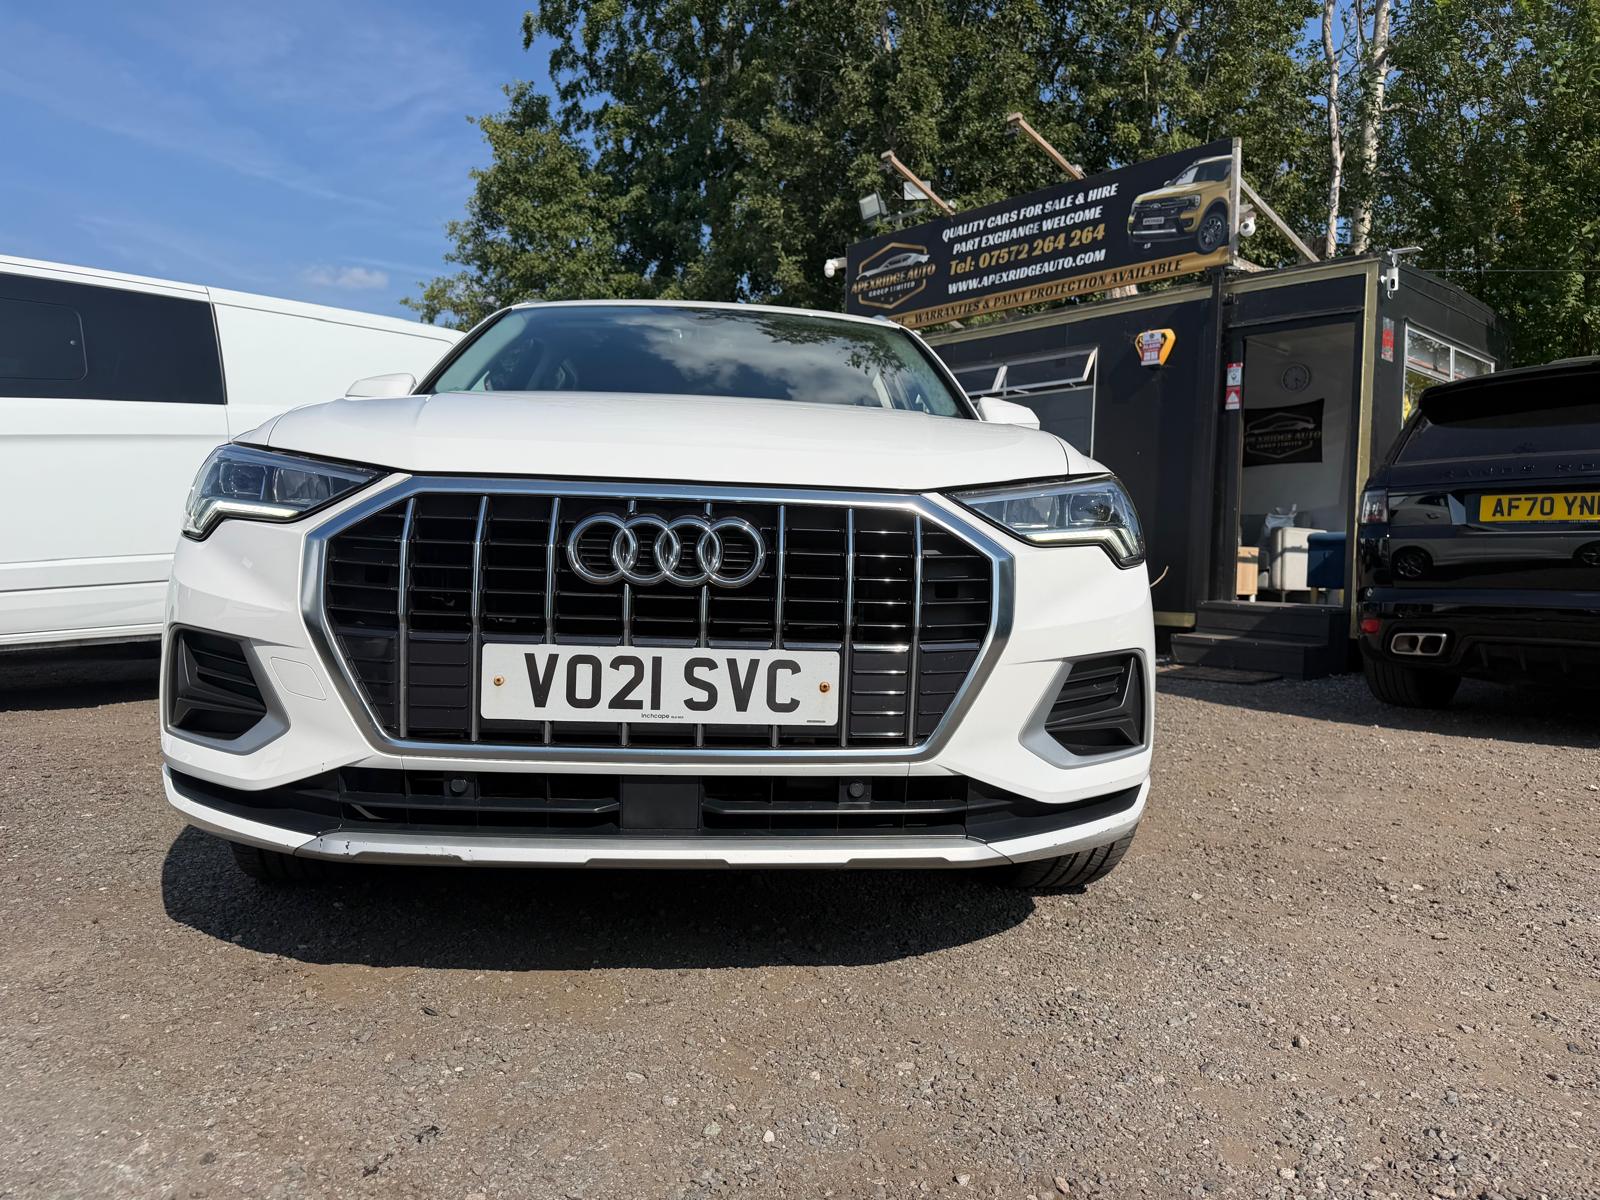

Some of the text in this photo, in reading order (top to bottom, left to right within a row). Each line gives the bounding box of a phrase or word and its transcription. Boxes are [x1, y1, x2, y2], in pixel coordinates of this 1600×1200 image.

[942, 182, 1119, 243] QUALITY CARS FOR SALE & HIRE
[952, 205, 1103, 255] PART EXCHANGE WELCOME
[906, 263, 937, 280] AUTO
[948, 248, 1106, 294] WWW.APEXRIDGEAUTO.COM
[950, 223, 1105, 275] Tel: 07572 264 264
[889, 281, 916, 292] LIMITED
[915, 302, 980, 324] WARRANTIES
[993, 291, 1027, 308] PAINT
[1029, 274, 1108, 301] PROTECTION
[1110, 259, 1183, 283] AVAILABLE
[1492, 496, 1555, 517] AF70
[524, 652, 801, 713] VO21 SVC
